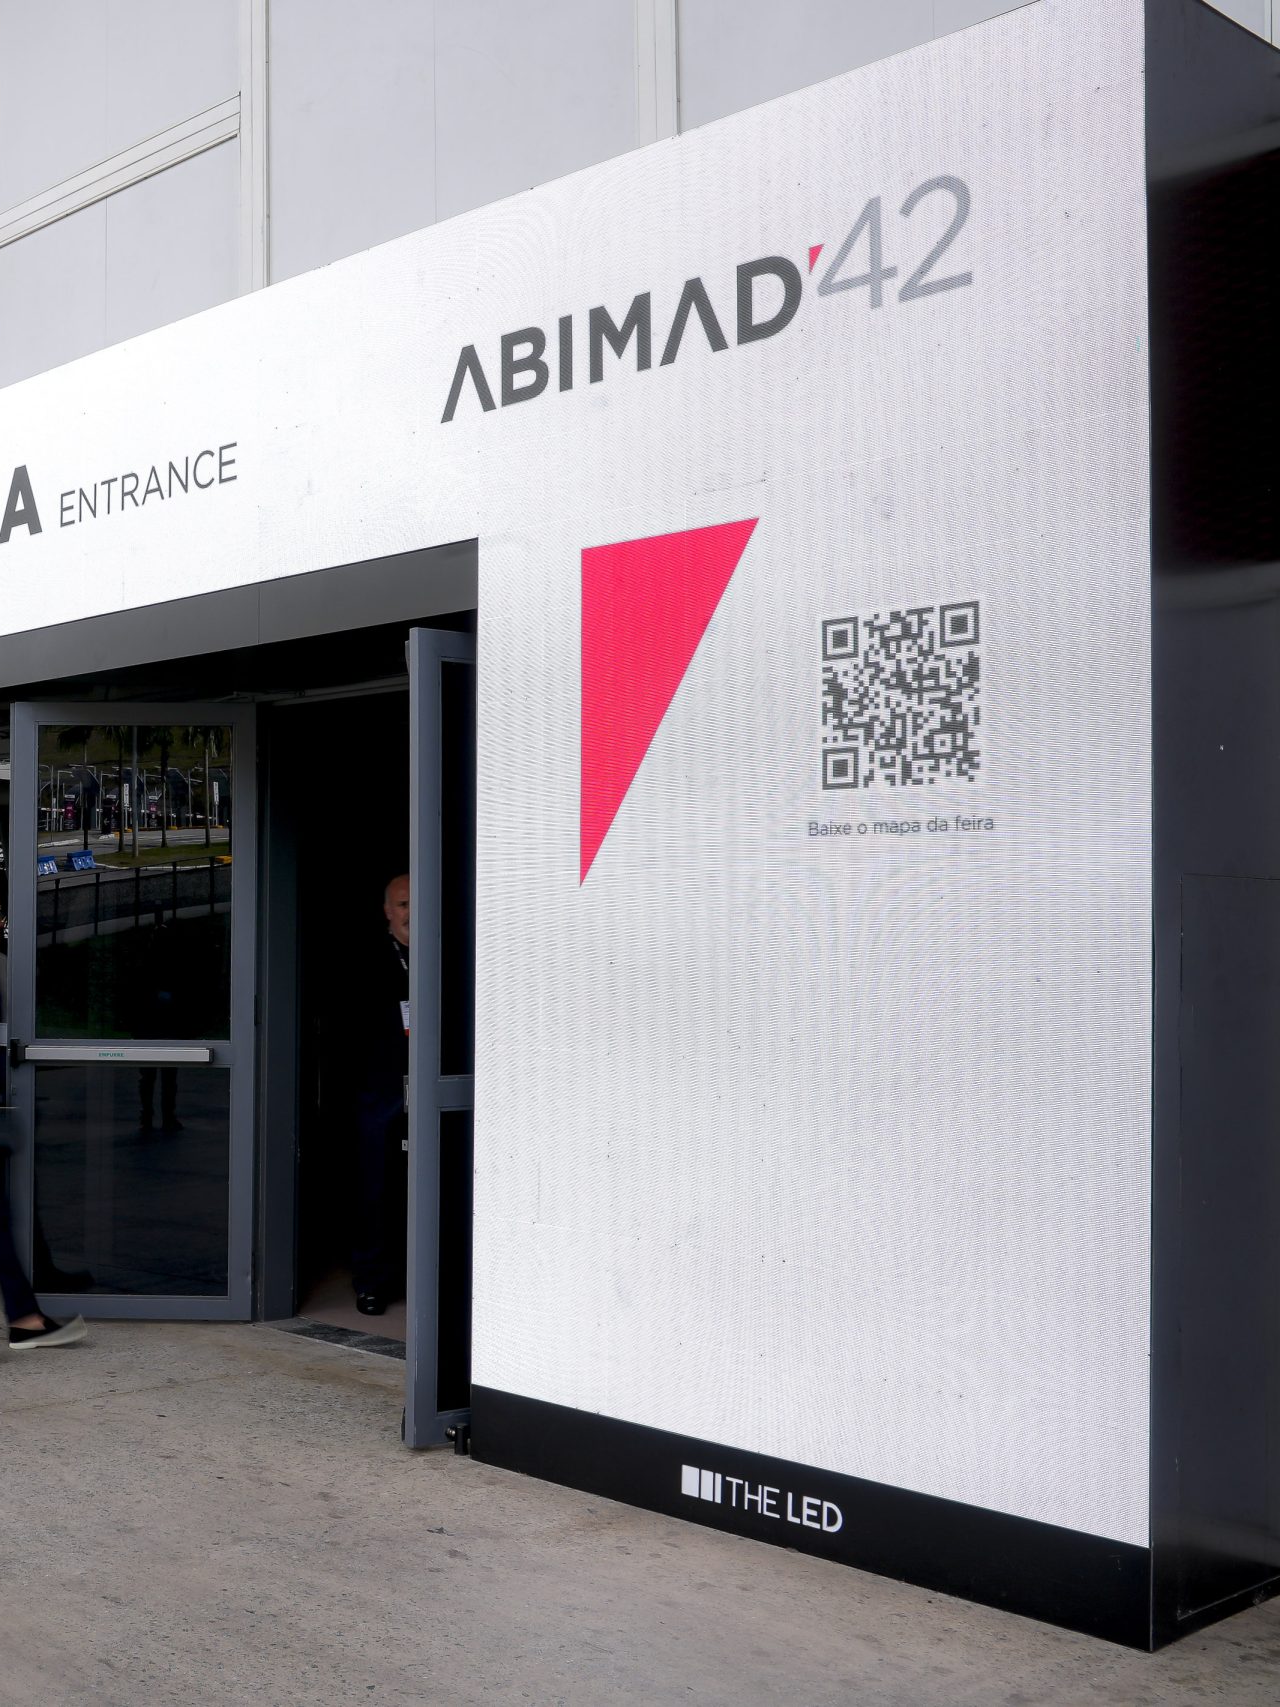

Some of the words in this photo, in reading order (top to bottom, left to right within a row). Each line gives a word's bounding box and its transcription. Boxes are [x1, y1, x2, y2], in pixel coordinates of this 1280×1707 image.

[59, 442, 238, 528] ENTRANCE
[808, 820, 852, 837] Baixe
[857, 823, 867, 835] o
[873, 820, 921, 837] mapa
[927, 817, 948, 833] da
[954, 815, 995, 832] feira
[725, 1476, 781, 1519] THE
[787, 1491, 843, 1533] LED
